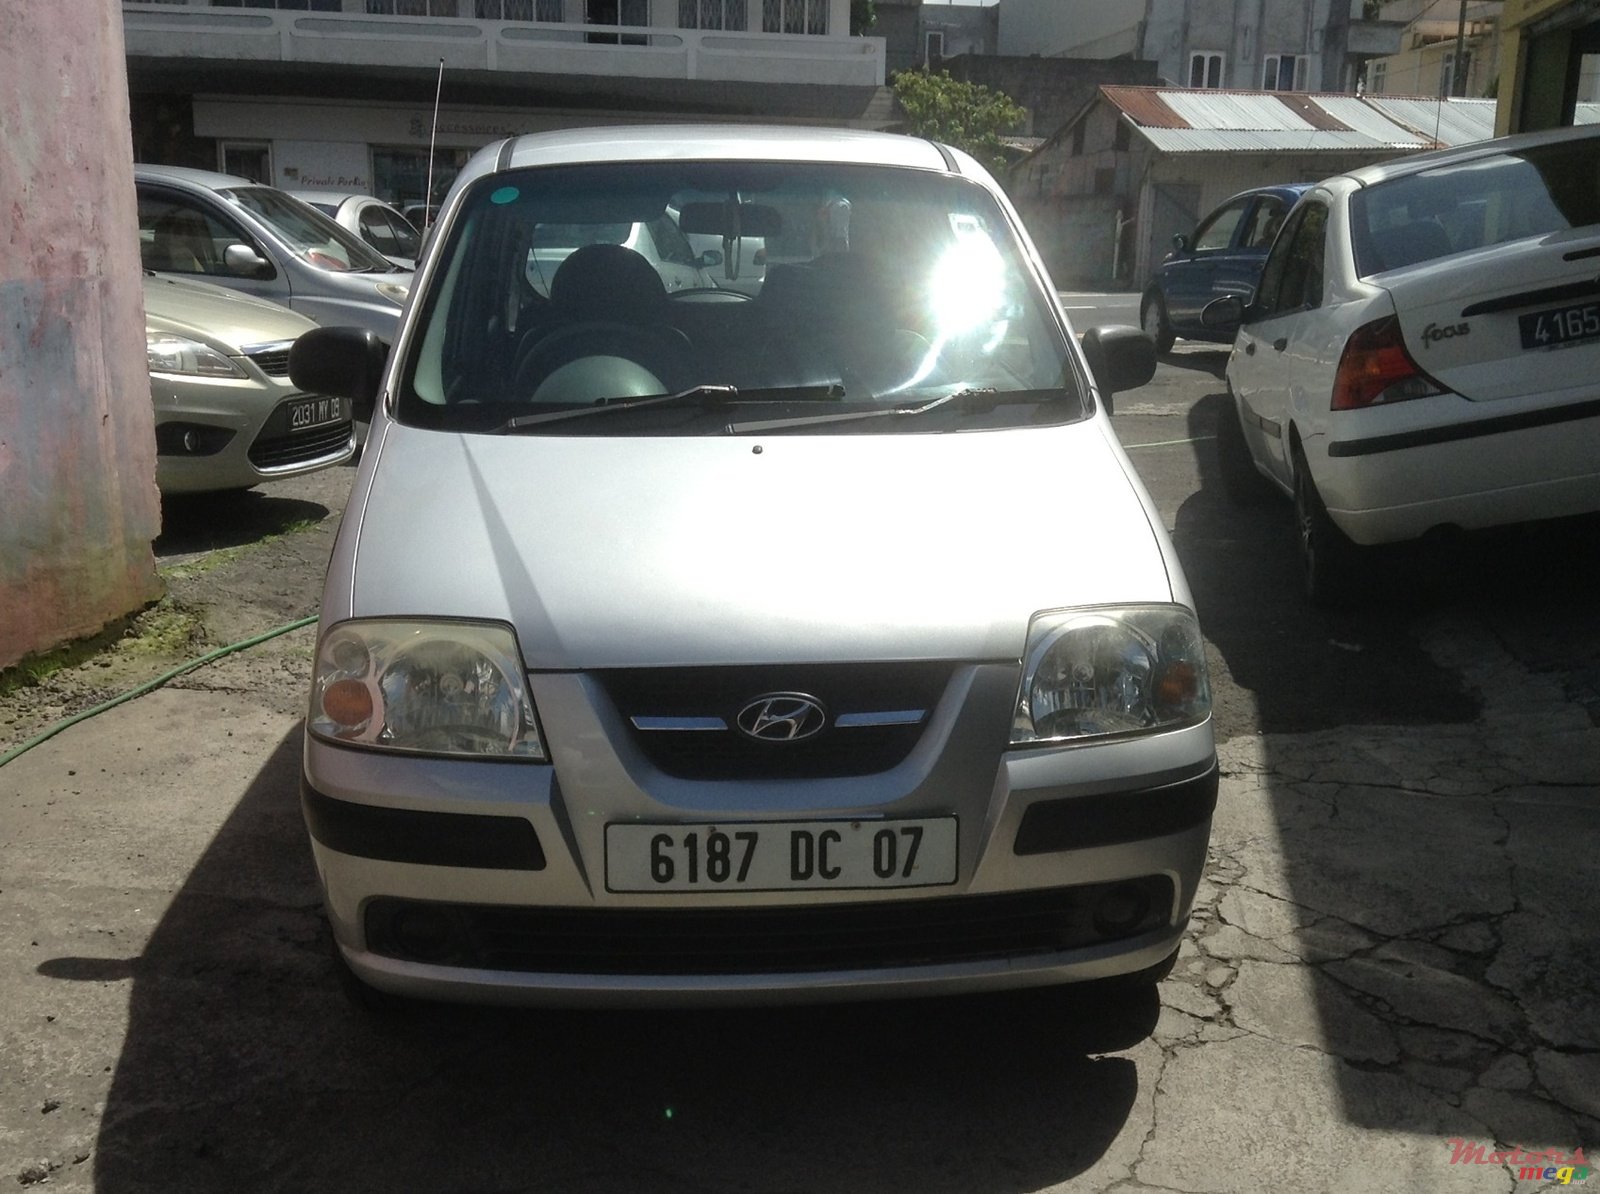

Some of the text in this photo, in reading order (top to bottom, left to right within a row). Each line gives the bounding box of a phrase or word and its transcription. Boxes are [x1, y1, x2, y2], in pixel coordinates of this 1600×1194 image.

[1535, 306, 1600, 342] 4165
[292, 403, 315, 426] 2031
[651, 826, 924, 883] 6187 DC 07
